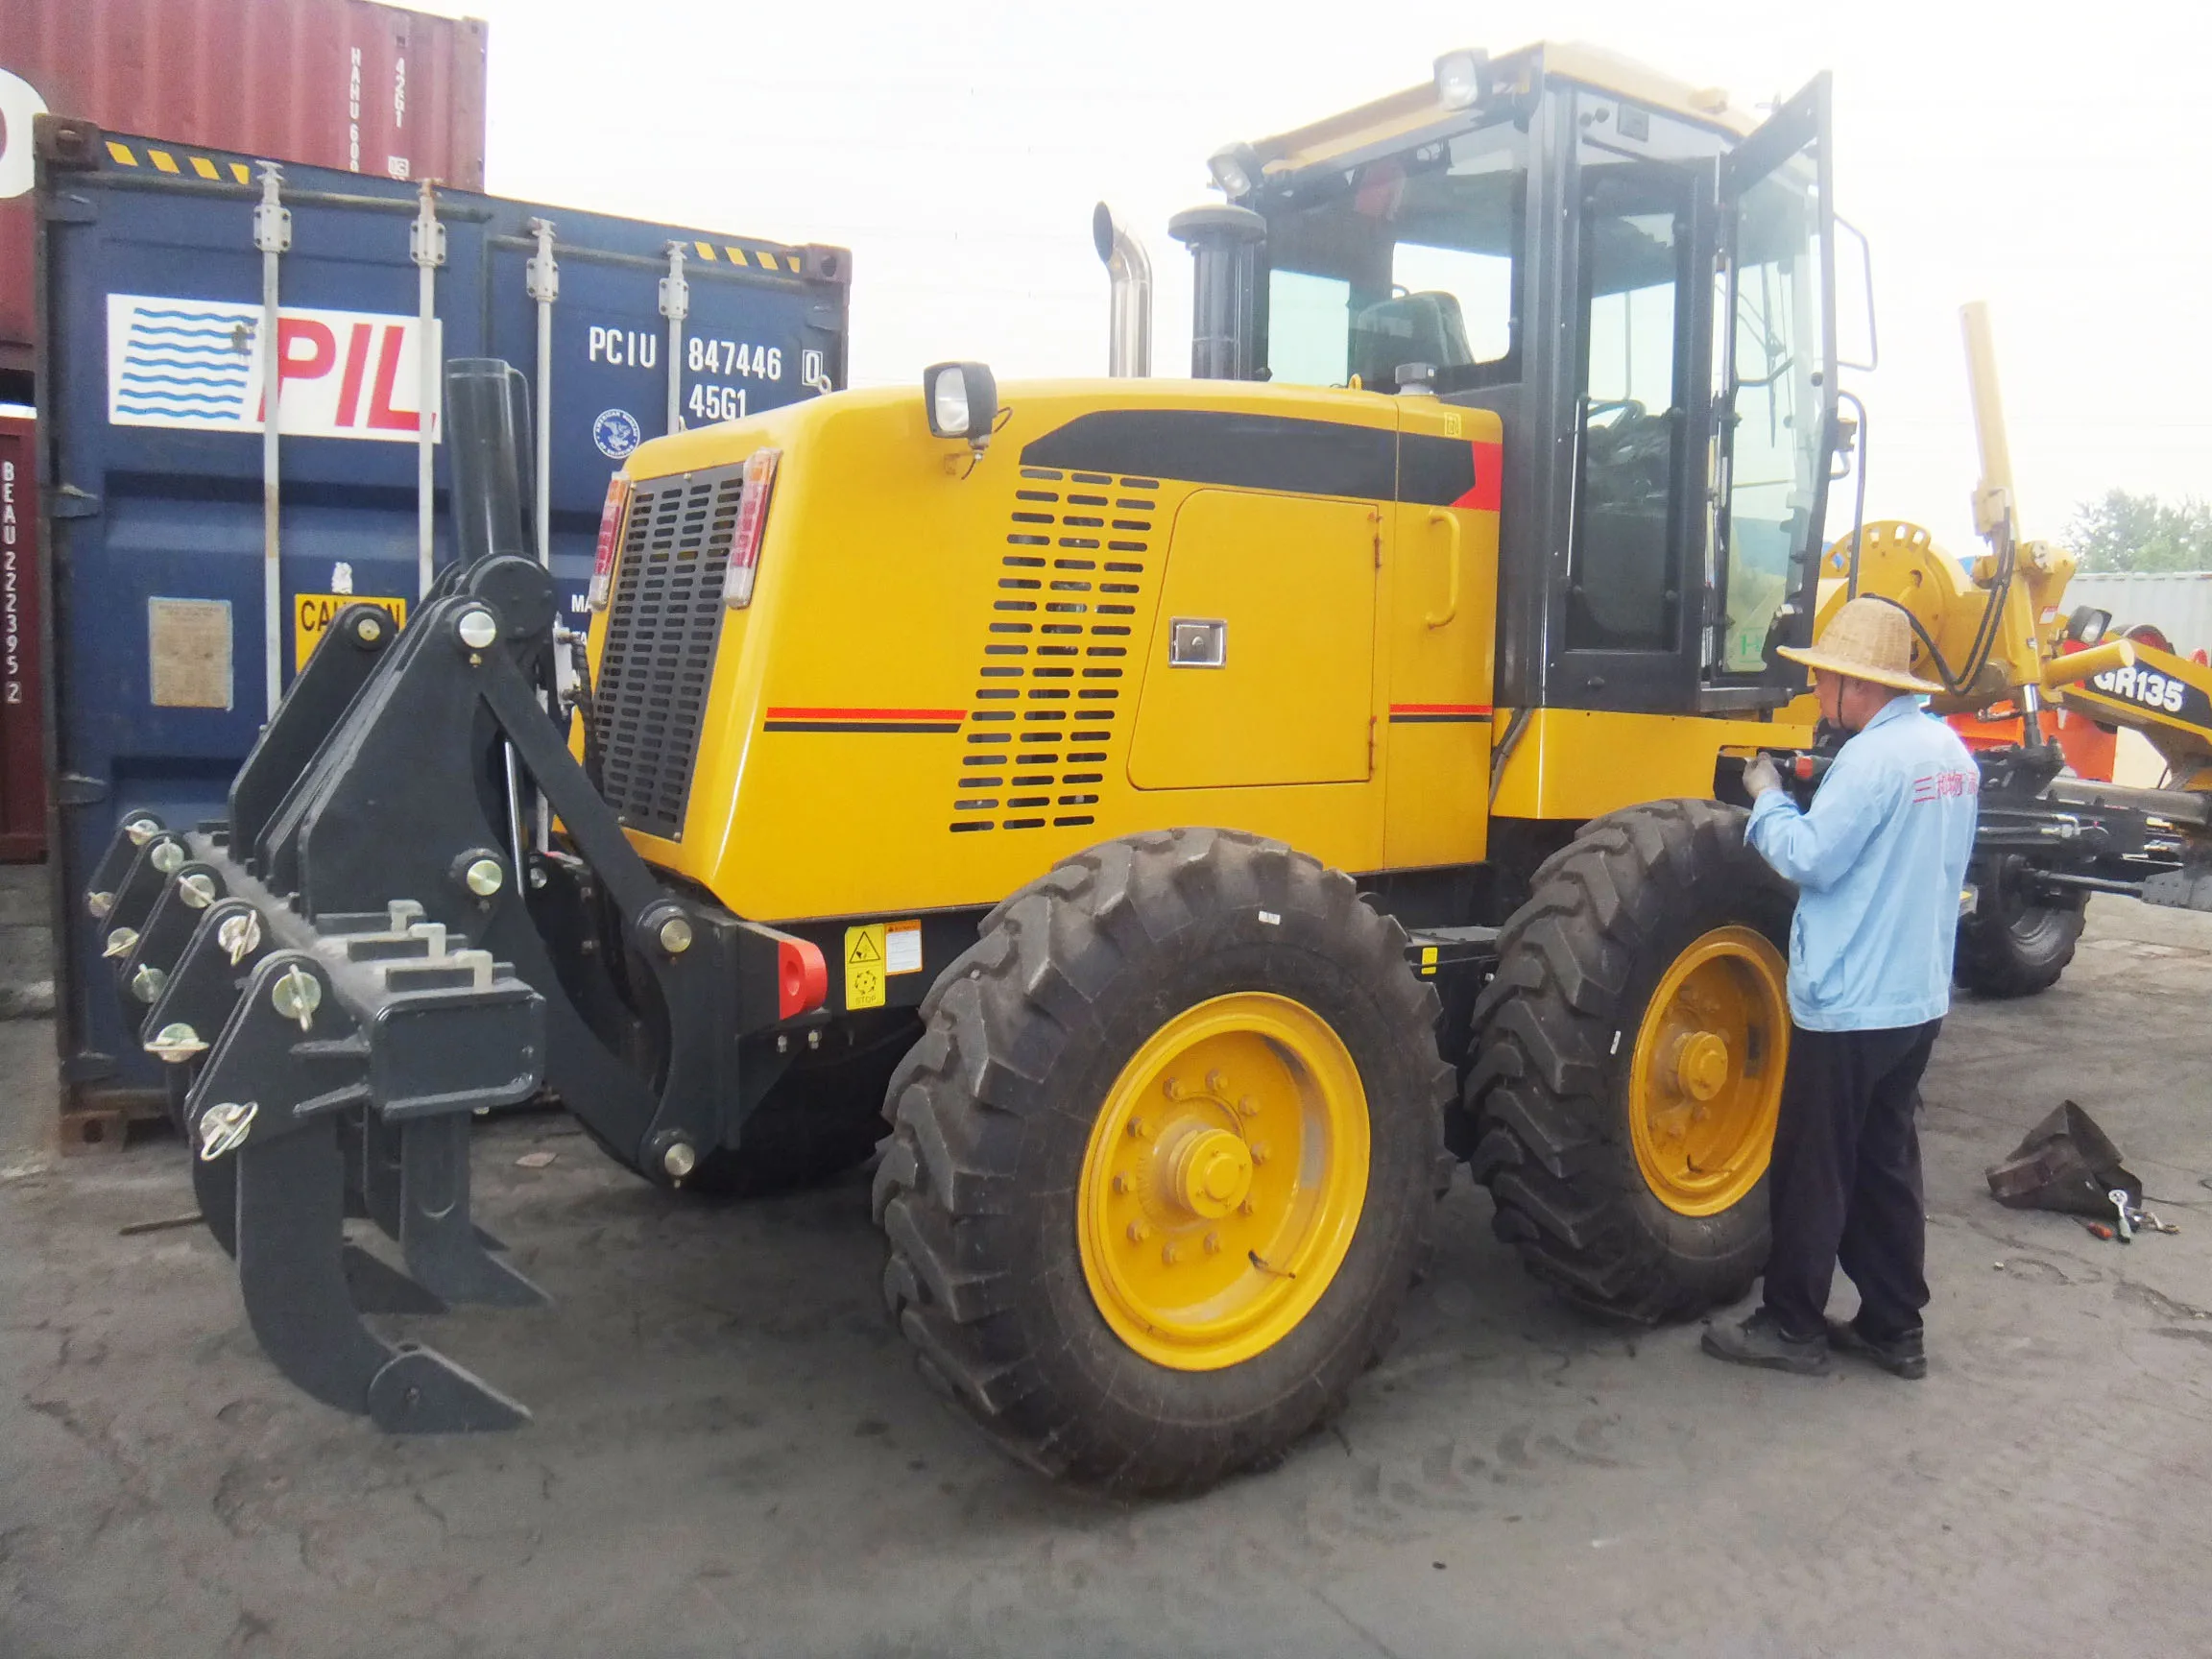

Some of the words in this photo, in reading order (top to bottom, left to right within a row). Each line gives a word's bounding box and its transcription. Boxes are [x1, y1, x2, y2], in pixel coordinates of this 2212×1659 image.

[257, 318, 436, 432] PIL
[589, 326, 657, 369] PCIU
[688, 337, 781, 380] 847446
[688, 384, 747, 421] 45G1
[3, 461, 15, 544] BEAU
[5, 551, 18, 674] 222395
[2094, 666, 2185, 711] GR135
[855, 996, 876, 1004] STOP
